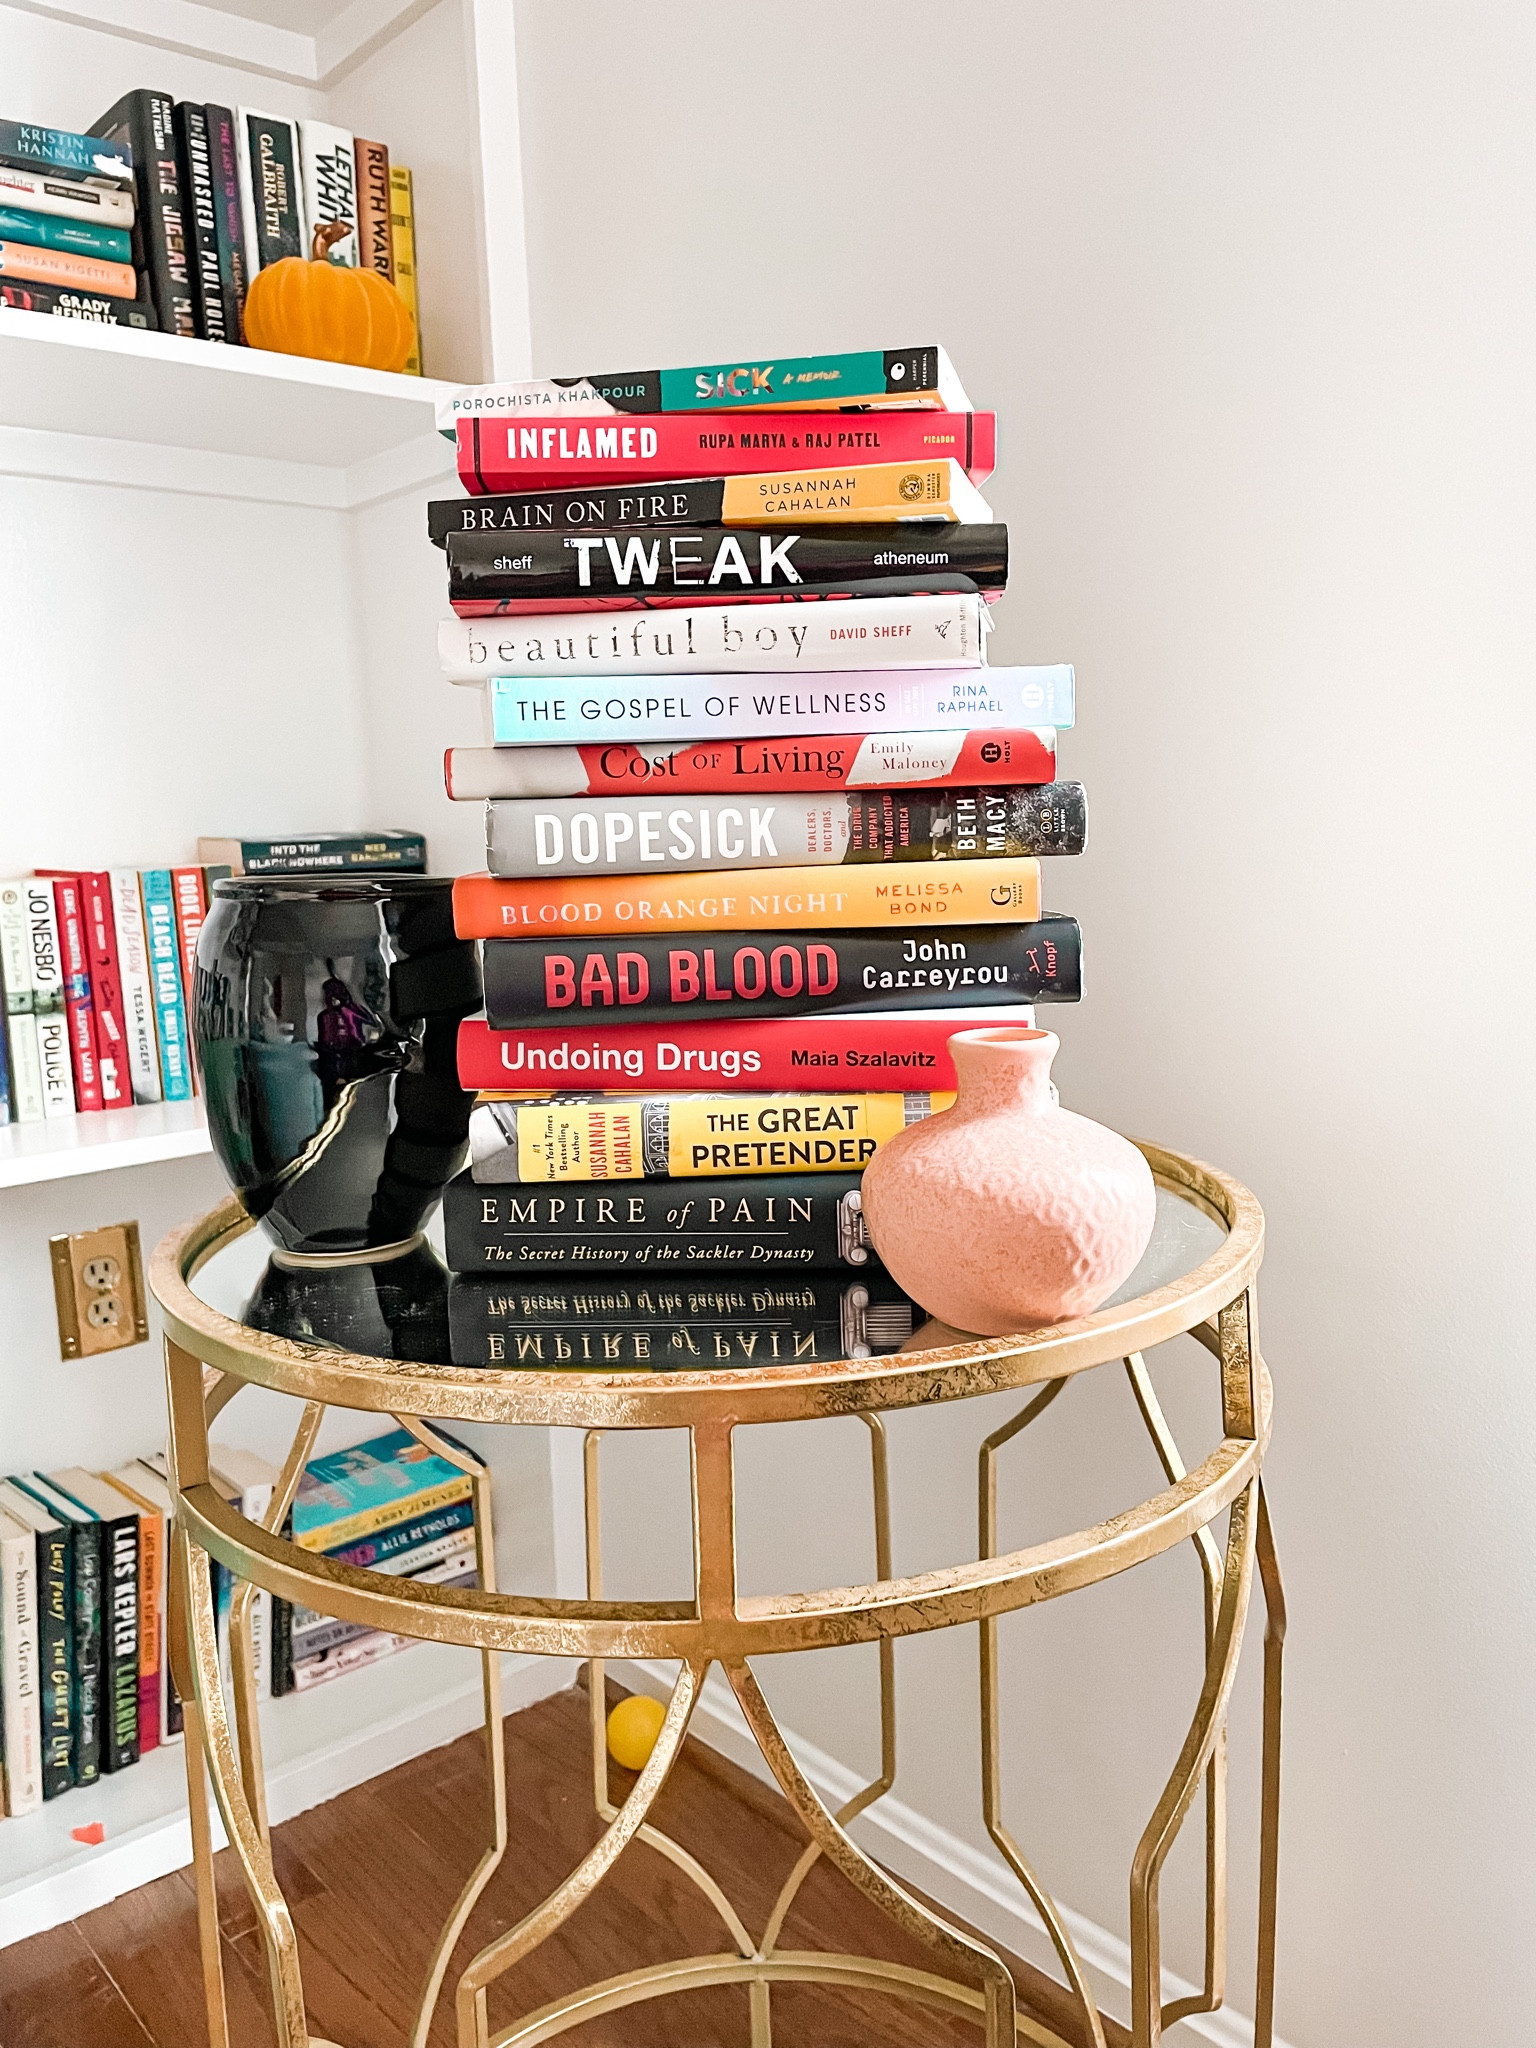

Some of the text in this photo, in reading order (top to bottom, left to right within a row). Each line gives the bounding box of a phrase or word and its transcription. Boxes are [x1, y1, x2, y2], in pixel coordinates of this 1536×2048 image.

[151, 99, 165, 151] MATHESON
[162, 101, 173, 135] NADINE
[220, 122, 230, 144] THE
[18, 140, 89, 165] HANNAH
[21, 127, 84, 149] KRISTIN
[158, 160, 178, 195] THE
[222, 148, 232, 176] LAST
[190, 139, 214, 229] UNMASKED
[226, 181, 235, 197] TO
[260, 133, 281, 239] GALBRAITH
[276, 163, 288, 214] ROBERT
[315, 154, 337, 223] WHIT
[334, 144, 354, 222] LETHA
[367, 149, 386, 213] RUTH
[162, 205, 188, 283] JIGSAW
[16, 254, 110, 278] SUSAN RIGETTI
[201, 251, 220, 290] PAUL
[59, 295, 111, 313] GRADY
[453, 385, 646, 411] POROCHISTA KHAKPOUR
[695, 366, 775, 399] SICK
[507, 427, 657, 459] INFLAMED
[700, 432, 881, 449] RUPA MARYA & RAJ PATEL
[924, 435, 955, 444] PICADOR
[759, 477, 856, 496] SUSANNAH
[461, 494, 690, 530] BRAIN ON FIRE
[765, 496, 851, 513] CAHALAN
[493, 555, 533, 570] sheff
[564, 535, 804, 587] TWEAK
[873, 551, 949, 566] atheneum
[468, 615, 808, 663] beautiful boy
[830, 624, 912, 640] DAVID SHEFF
[960, 623, 968, 657] Houghton
[517, 699, 567, 721] THE
[581, 698, 691, 721] GOSPEL
[705, 696, 740, 717] OF
[752, 693, 886, 716] WELLNESS
[937, 700, 1003, 713] RAPHAEL
[952, 685, 988, 698] RINA
[600, 744, 845, 779] Cost OF Living
[870, 742, 914, 756] Emily
[882, 757, 947, 771] Maloney
[534, 807, 780, 866] DOPESICK
[807, 808, 816, 852] DEALERS,
[823, 807, 832, 852] DOCTORS,
[838, 820, 846, 838] and
[852, 807, 862, 851] THE DRUG
[869, 807, 878, 849] COMPANY
[883, 795, 893, 859] THAT ADDICTED
[899, 807, 909, 847] AMERICA
[957, 798, 978, 851] BETH
[985, 795, 1006, 852] MACY
[270, 844, 321, 855] INTO THE
[28, 889, 50, 913] JO
[178, 874, 200, 915] BOOK
[876, 882, 963, 898] MELISSA
[501, 893, 848, 925] BLOOD ORANGE NIGHT
[890, 902, 947, 915] BOND
[150, 904, 177, 1004] BEACH READ
[902, 939, 967, 963] John
[1045, 940, 1058, 978] Knopf
[544, 944, 839, 1008] BAD BLOOD
[862, 963, 1008, 991] Carreyrou
[133, 986, 150, 1073] TESSA WEGERT
[42, 1025, 67, 1090] POLICE
[501, 1041, 761, 1078] Undoing Drugs
[791, 1050, 936, 1067] Maia Szalavitz
[707, 1105, 859, 1134] THE GREAT
[532, 1144, 541, 1154] #1
[544, 1115, 556, 1179] New York Times
[558, 1123, 569, 1171] Bestselling
[572, 1131, 581, 1163] Author
[588, 1112, 608, 1178] SUSANNAH
[613, 1116, 632, 1173] CAHALAN
[692, 1138, 877, 1168] PRETENDER
[481, 1197, 813, 1230] EMPIRE of PAIN
[485, 1244, 815, 1265] The Secret History of the Sackler Dynasty
[381, 1532, 409, 1552] ALLIE
[15, 1569, 31, 1624] Sound
[113, 1526, 137, 1657] LARS KEPLER
[17, 1641, 33, 1698] Gravel
[115, 1662, 137, 1747] LAZARUS
